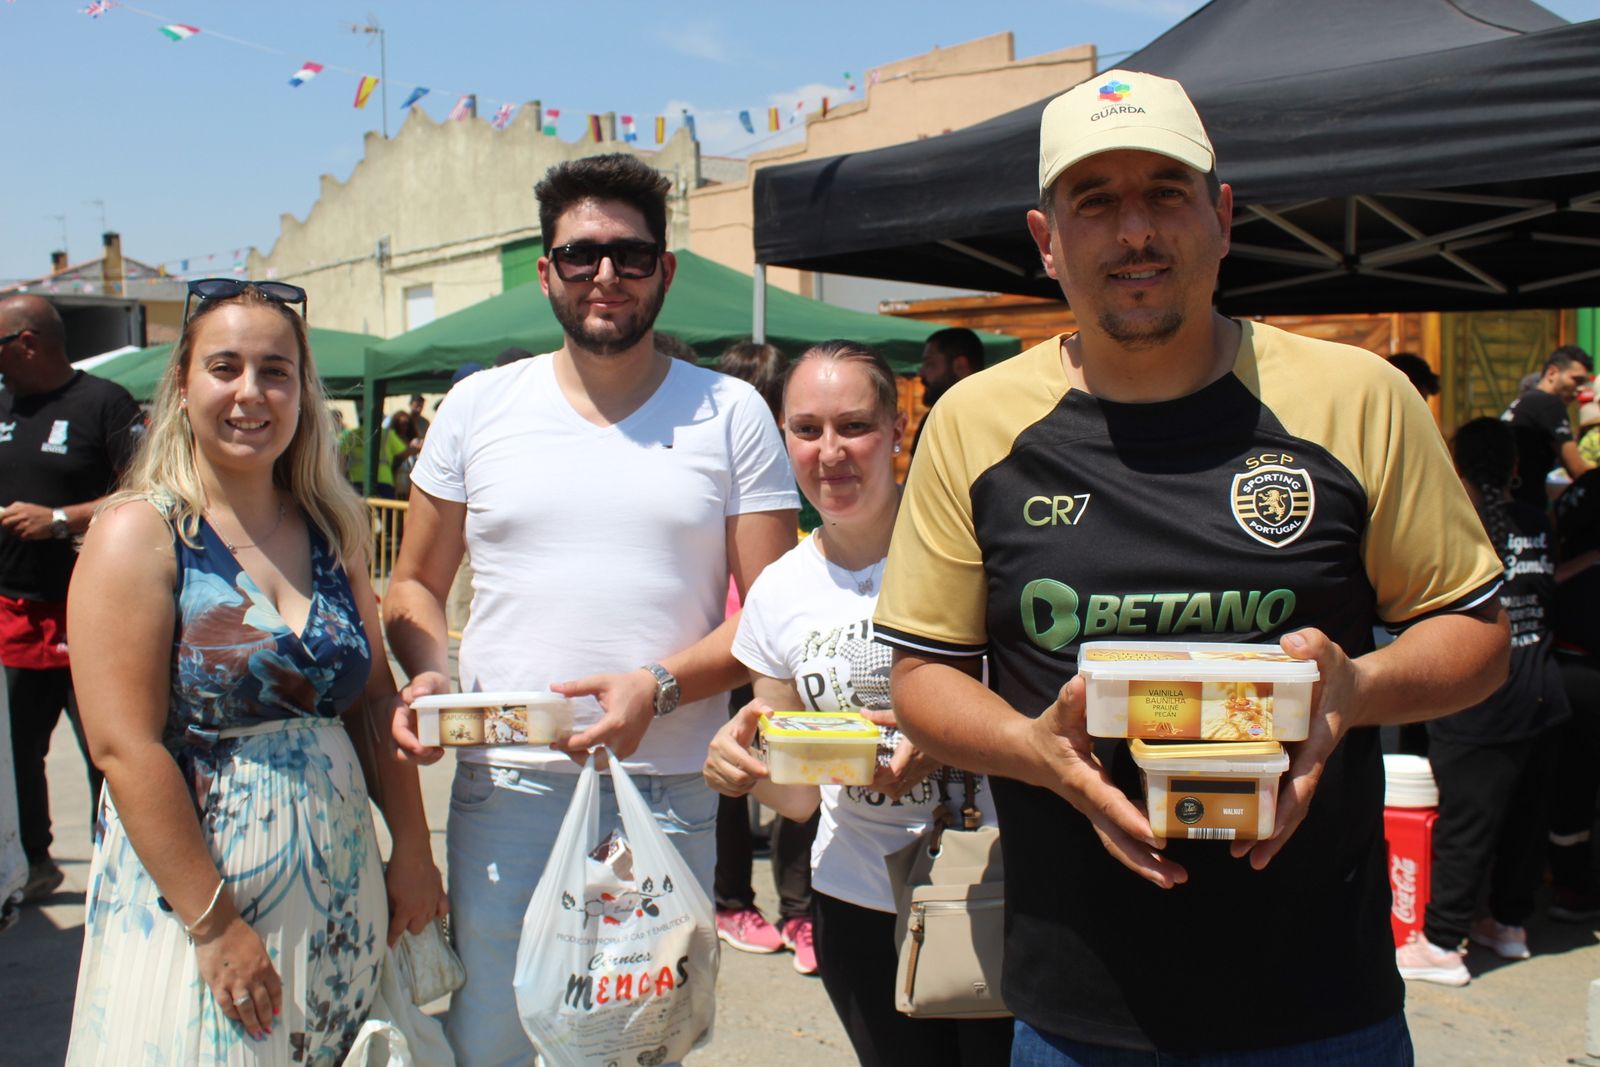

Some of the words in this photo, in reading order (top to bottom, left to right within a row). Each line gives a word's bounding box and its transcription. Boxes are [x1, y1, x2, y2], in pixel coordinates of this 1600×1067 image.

[1090, 106, 1146, 122] GUARDA
[1245, 453, 1294, 470] SCP
[1242, 473, 1301, 493] SPORTING
[1022, 493, 1091, 526] CR7
[1249, 519, 1303, 535] PORTUGAL
[1083, 588, 1297, 637] BETANO
[1148, 688, 1184, 697] VAINILLA
[1222, 807, 1244, 816] WALNUT
